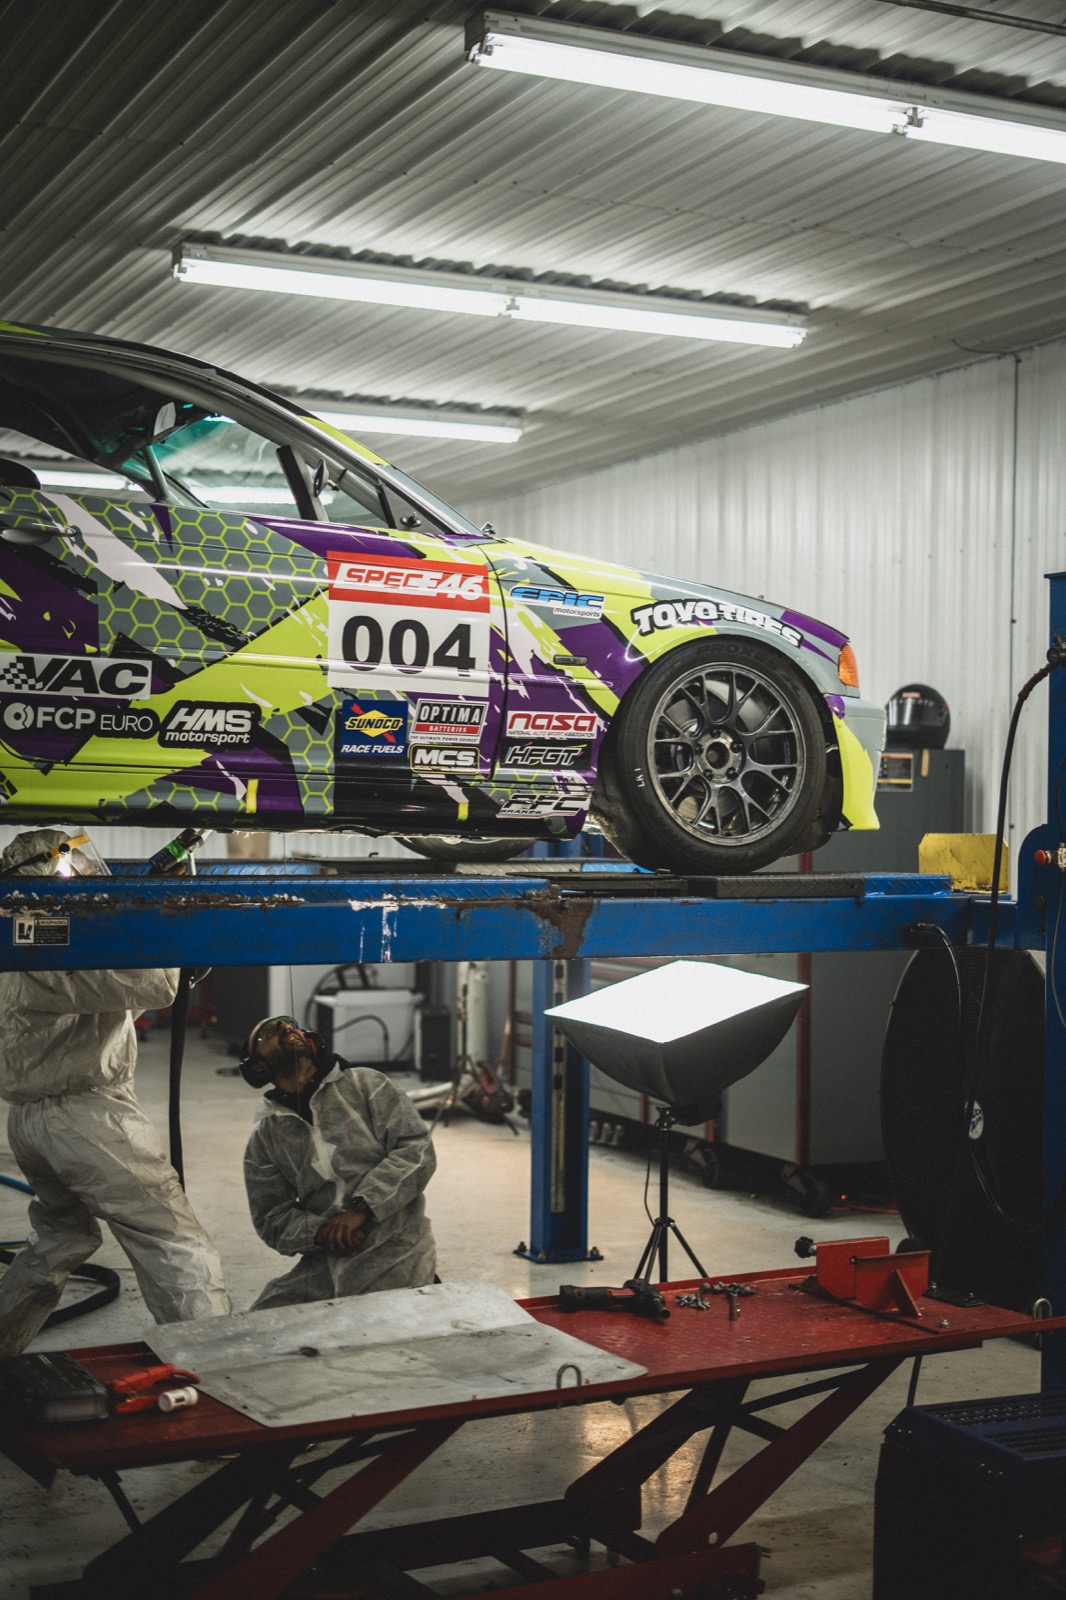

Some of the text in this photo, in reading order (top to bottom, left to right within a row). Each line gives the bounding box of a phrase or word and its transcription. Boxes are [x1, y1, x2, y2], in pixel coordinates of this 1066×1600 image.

[554, 606, 601, 618] motorsports
[633, 601, 803, 648] TOYO TIRES
[341, 615, 477, 677] 004
[6, 655, 150, 696] VAC
[36, 706, 154, 733] FCP EURO
[166, 707, 252, 733] HMS
[420, 705, 481, 723] OPTIMA
[347, 717, 401, 730] SUNOCO
[428, 725, 468, 733] BATTERIES
[165, 730, 251, 746] motorsport
[341, 744, 405, 754] RACE FUELS
[414, 749, 476, 766] MCS
[505, 746, 582, 766] HFGT
